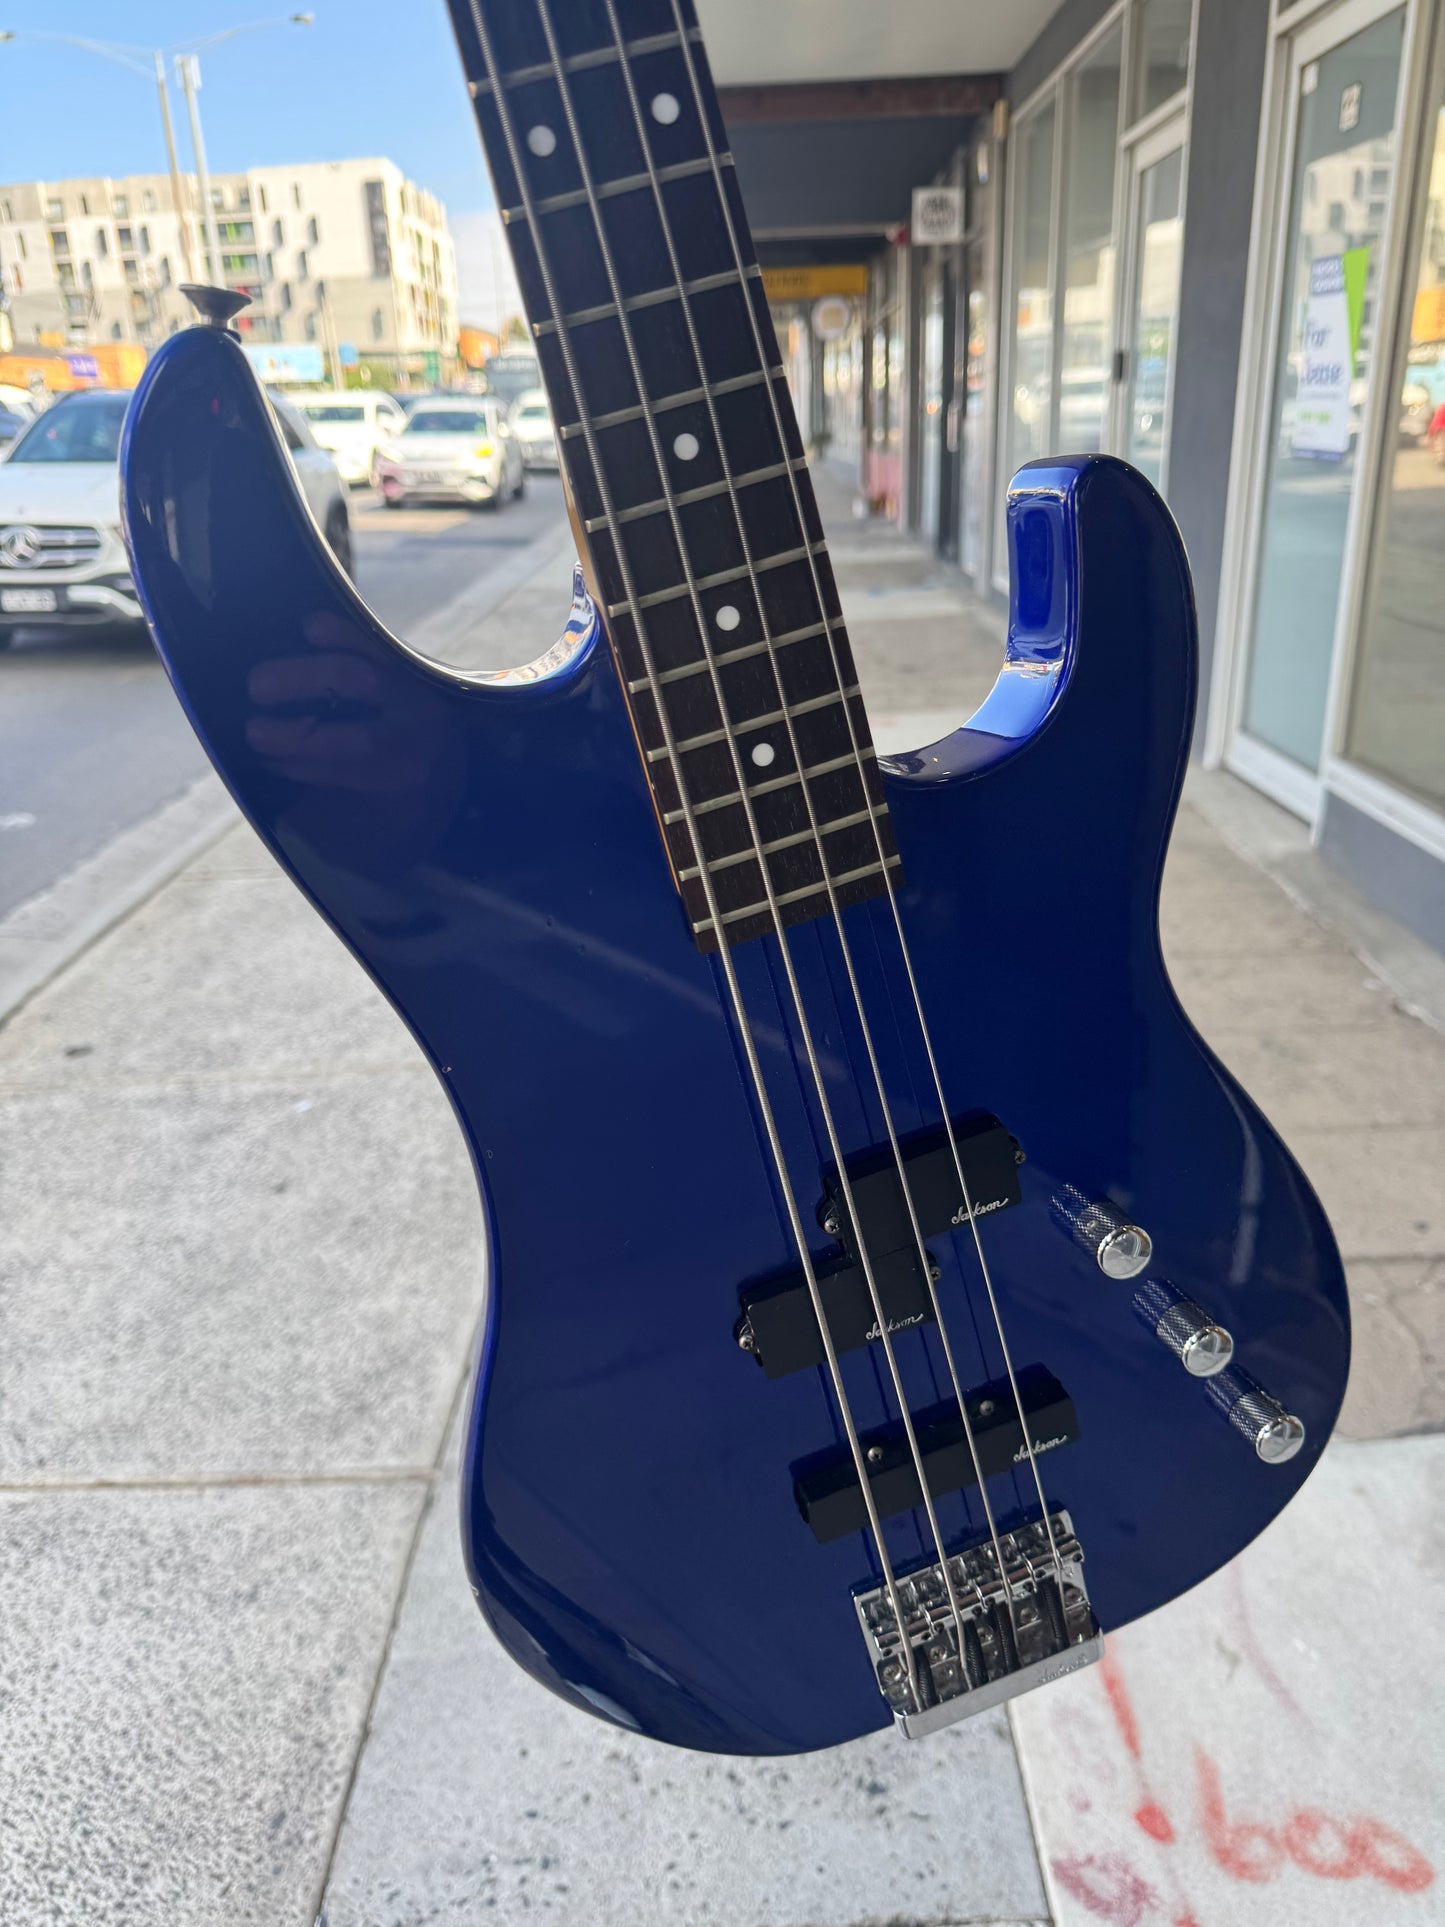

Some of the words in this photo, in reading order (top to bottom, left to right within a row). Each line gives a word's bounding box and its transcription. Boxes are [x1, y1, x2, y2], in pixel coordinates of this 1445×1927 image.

[951, 1197, 1009, 1225] Jakson
[865, 1313, 924, 1340] Jakson
[1013, 1434, 1068, 1462] Jakson
